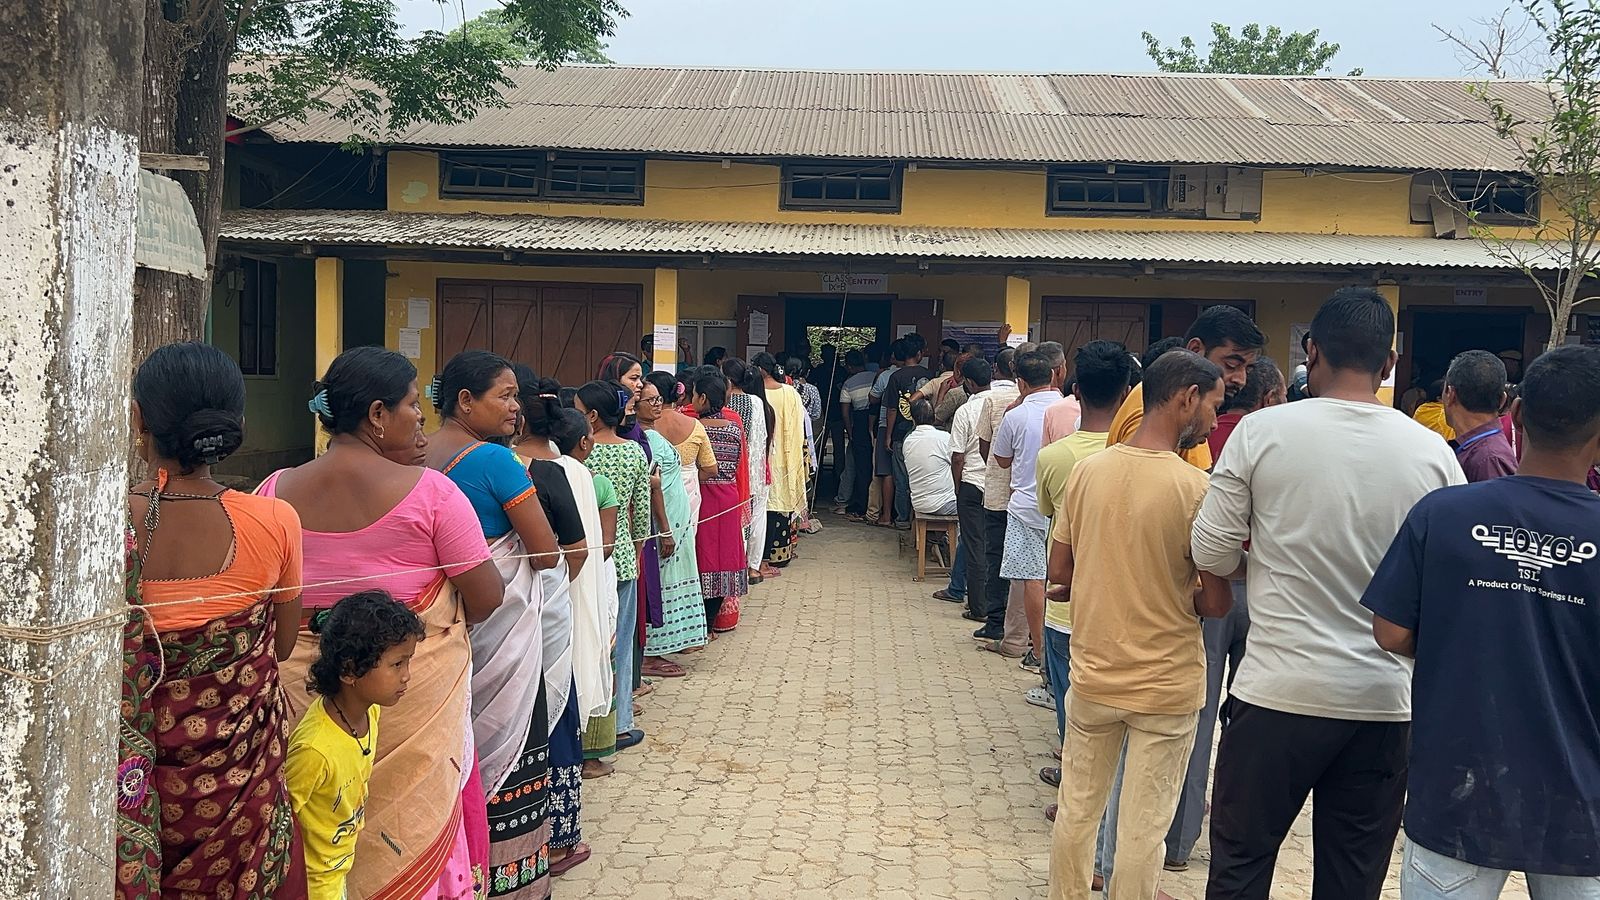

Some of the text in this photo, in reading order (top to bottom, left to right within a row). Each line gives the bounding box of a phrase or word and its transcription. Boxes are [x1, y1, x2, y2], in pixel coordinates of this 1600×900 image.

[1468, 579, 1475, 587] A
[1477, 580, 1509, 590] Product
[1511, 582, 1522, 590] Of
[1538, 587, 1566, 602] Springs
[1567, 595, 1587, 606] Ltd.
